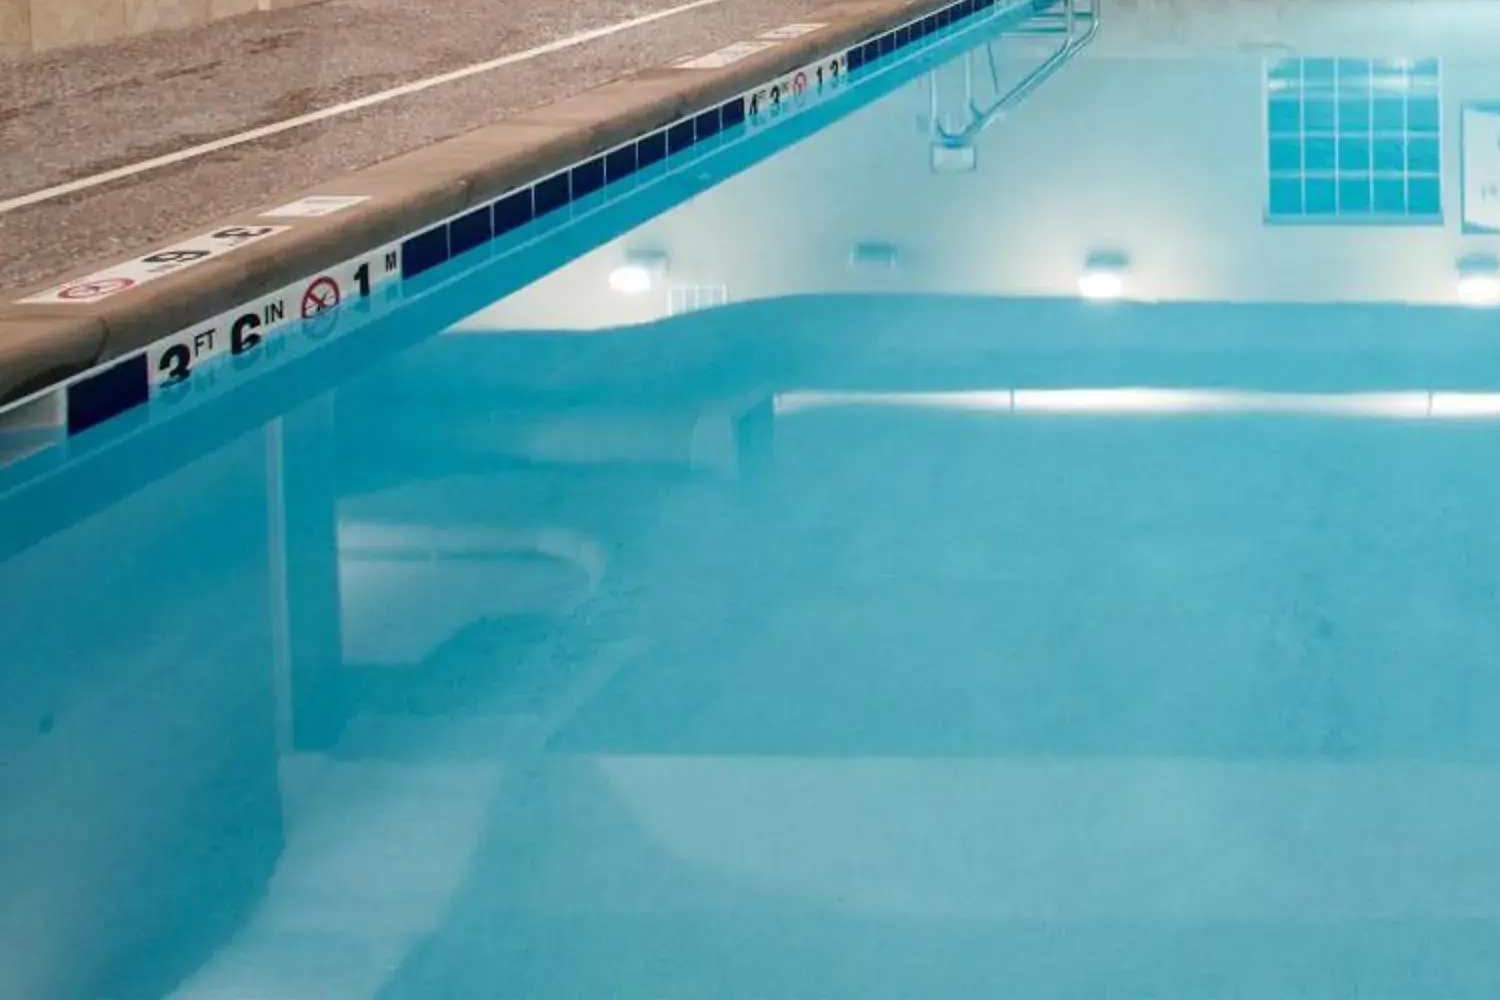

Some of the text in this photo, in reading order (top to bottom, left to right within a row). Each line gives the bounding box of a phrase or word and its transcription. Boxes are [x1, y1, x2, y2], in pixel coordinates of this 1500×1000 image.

[159, 343, 191, 388] 3
[194, 328, 216, 357] FT
[231, 313, 261, 355] 6
[264, 300, 285, 325] IN
[353, 262, 370, 297] 1
